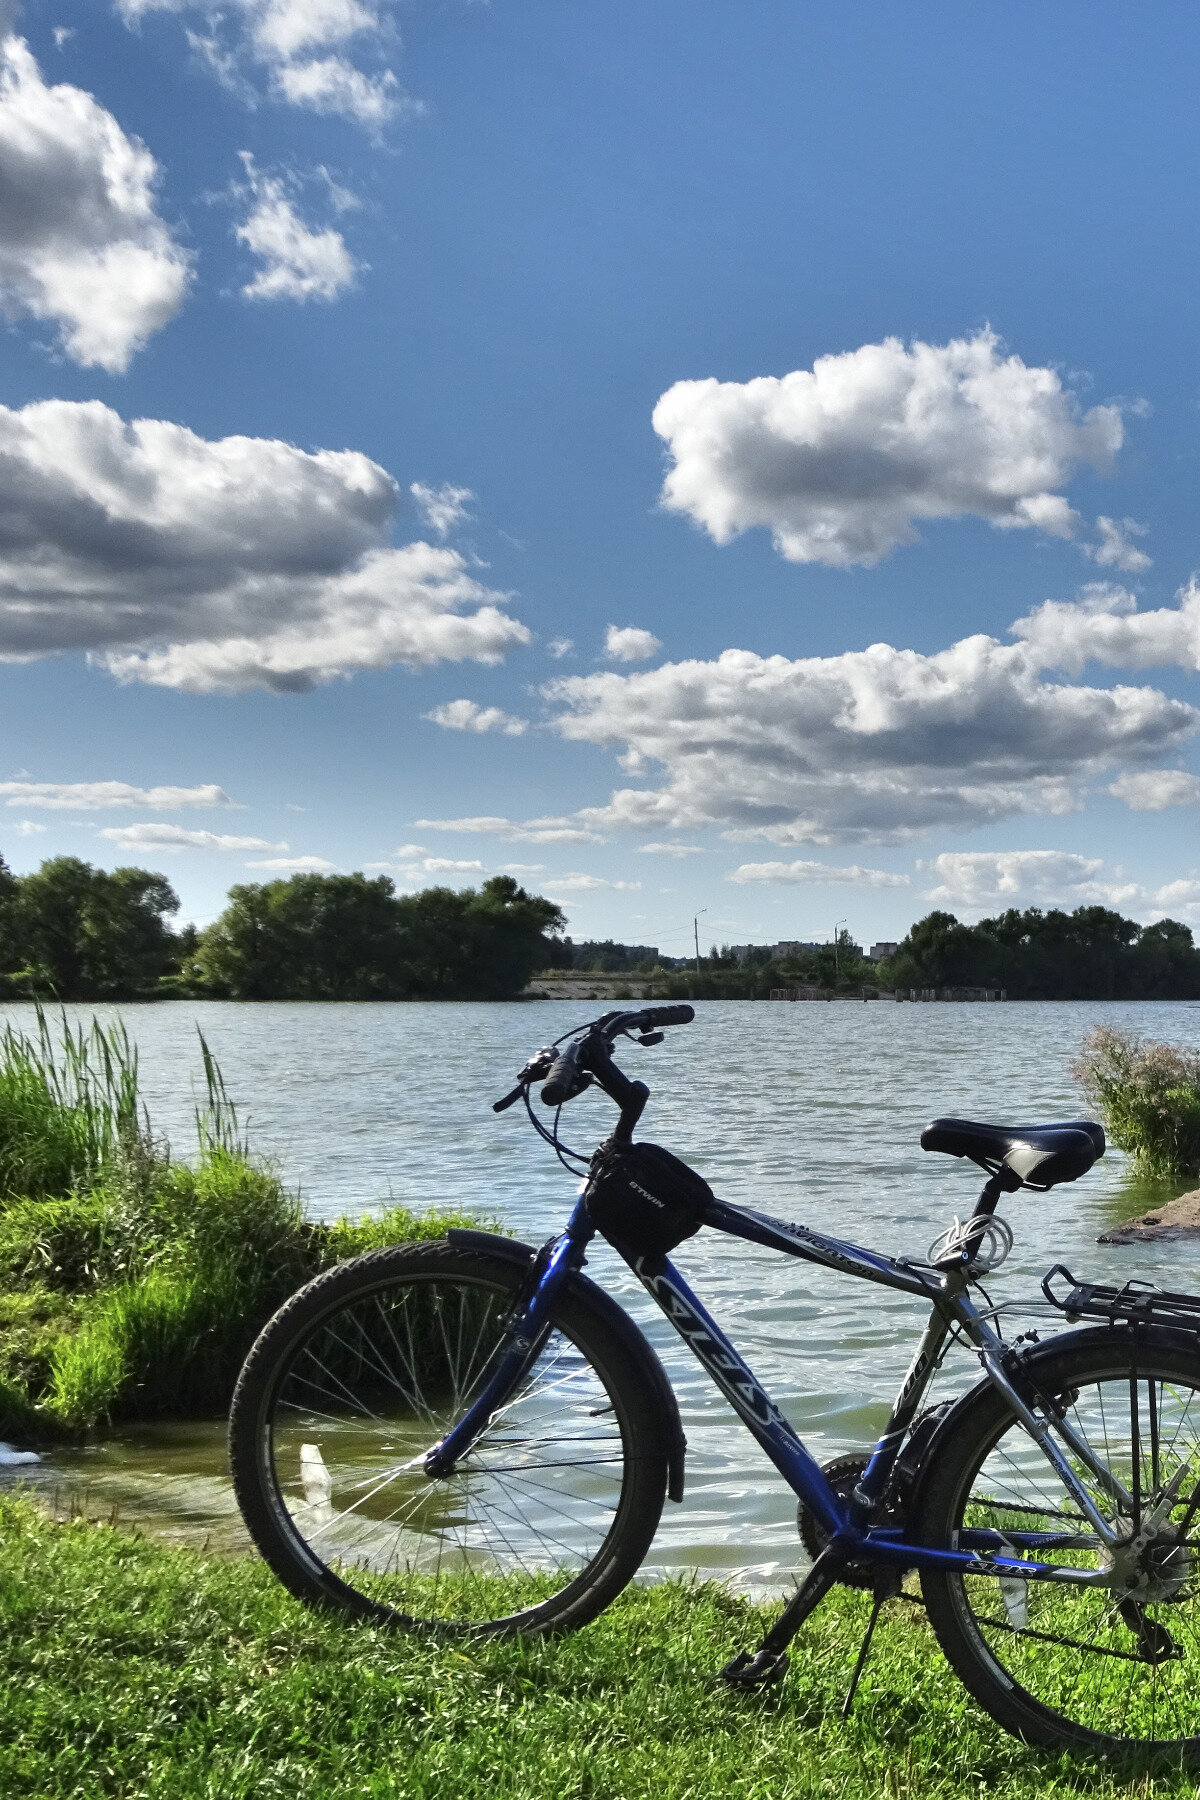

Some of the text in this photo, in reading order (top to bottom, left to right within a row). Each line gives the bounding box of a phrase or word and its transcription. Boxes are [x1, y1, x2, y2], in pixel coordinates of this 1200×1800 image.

[774, 1220, 877, 1277] NAVIGATOR
[636, 1256, 784, 1425] STELS
[966, 1559, 1037, 1577] STELS
